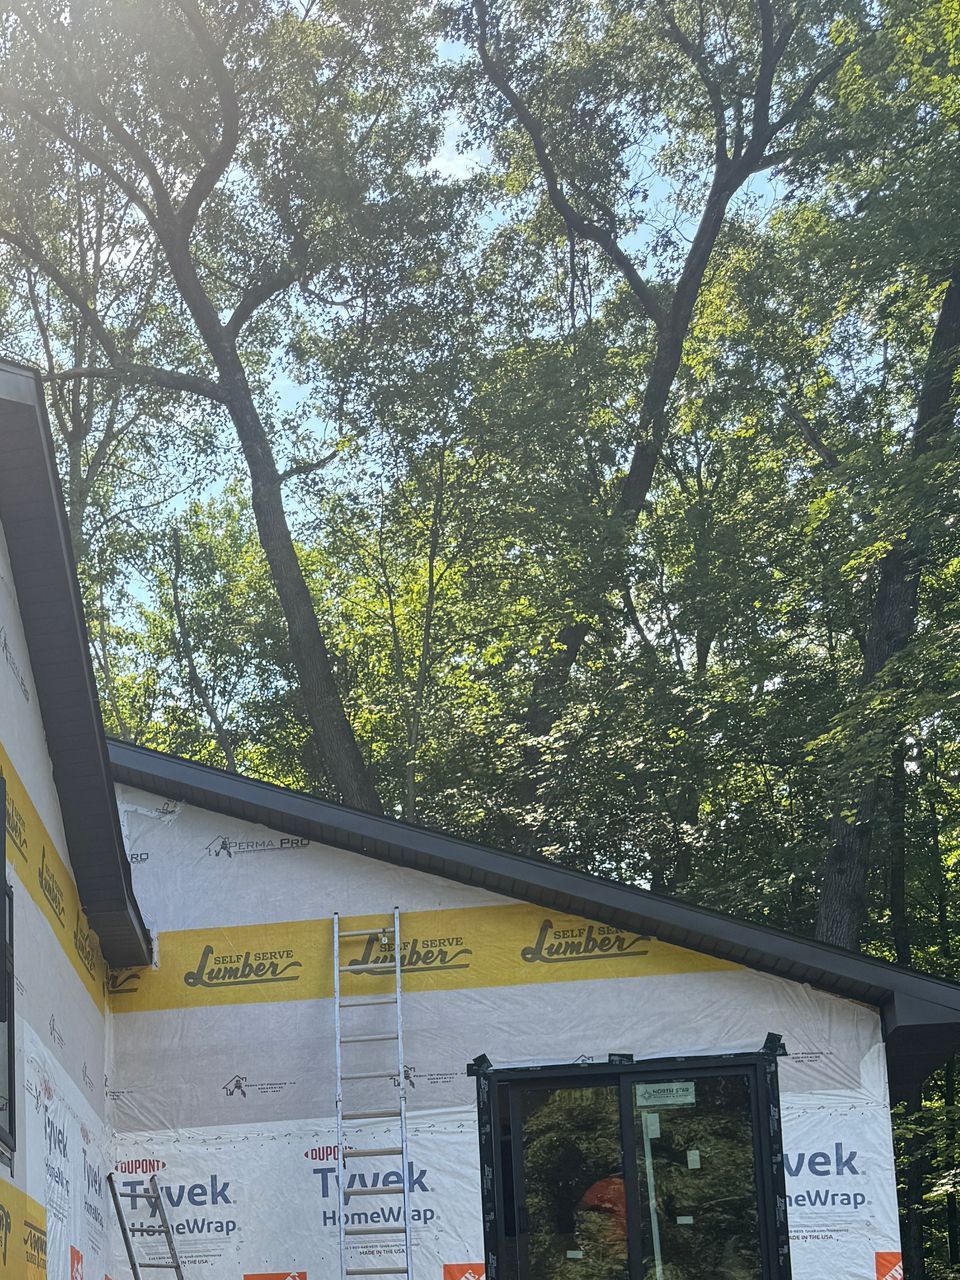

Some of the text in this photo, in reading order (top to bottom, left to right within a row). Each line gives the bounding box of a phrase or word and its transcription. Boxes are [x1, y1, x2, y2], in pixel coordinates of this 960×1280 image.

[228, 838, 310, 850] PERMA PRO
[521, 918, 651, 963] Lumber
[553, 928, 586, 940] SELF
[422, 936, 463, 949] SERVE
[214, 949, 294, 966] SELF SERVE
[184, 944, 302, 988] Lumber
[120, 1159, 161, 1175] DUPONT
